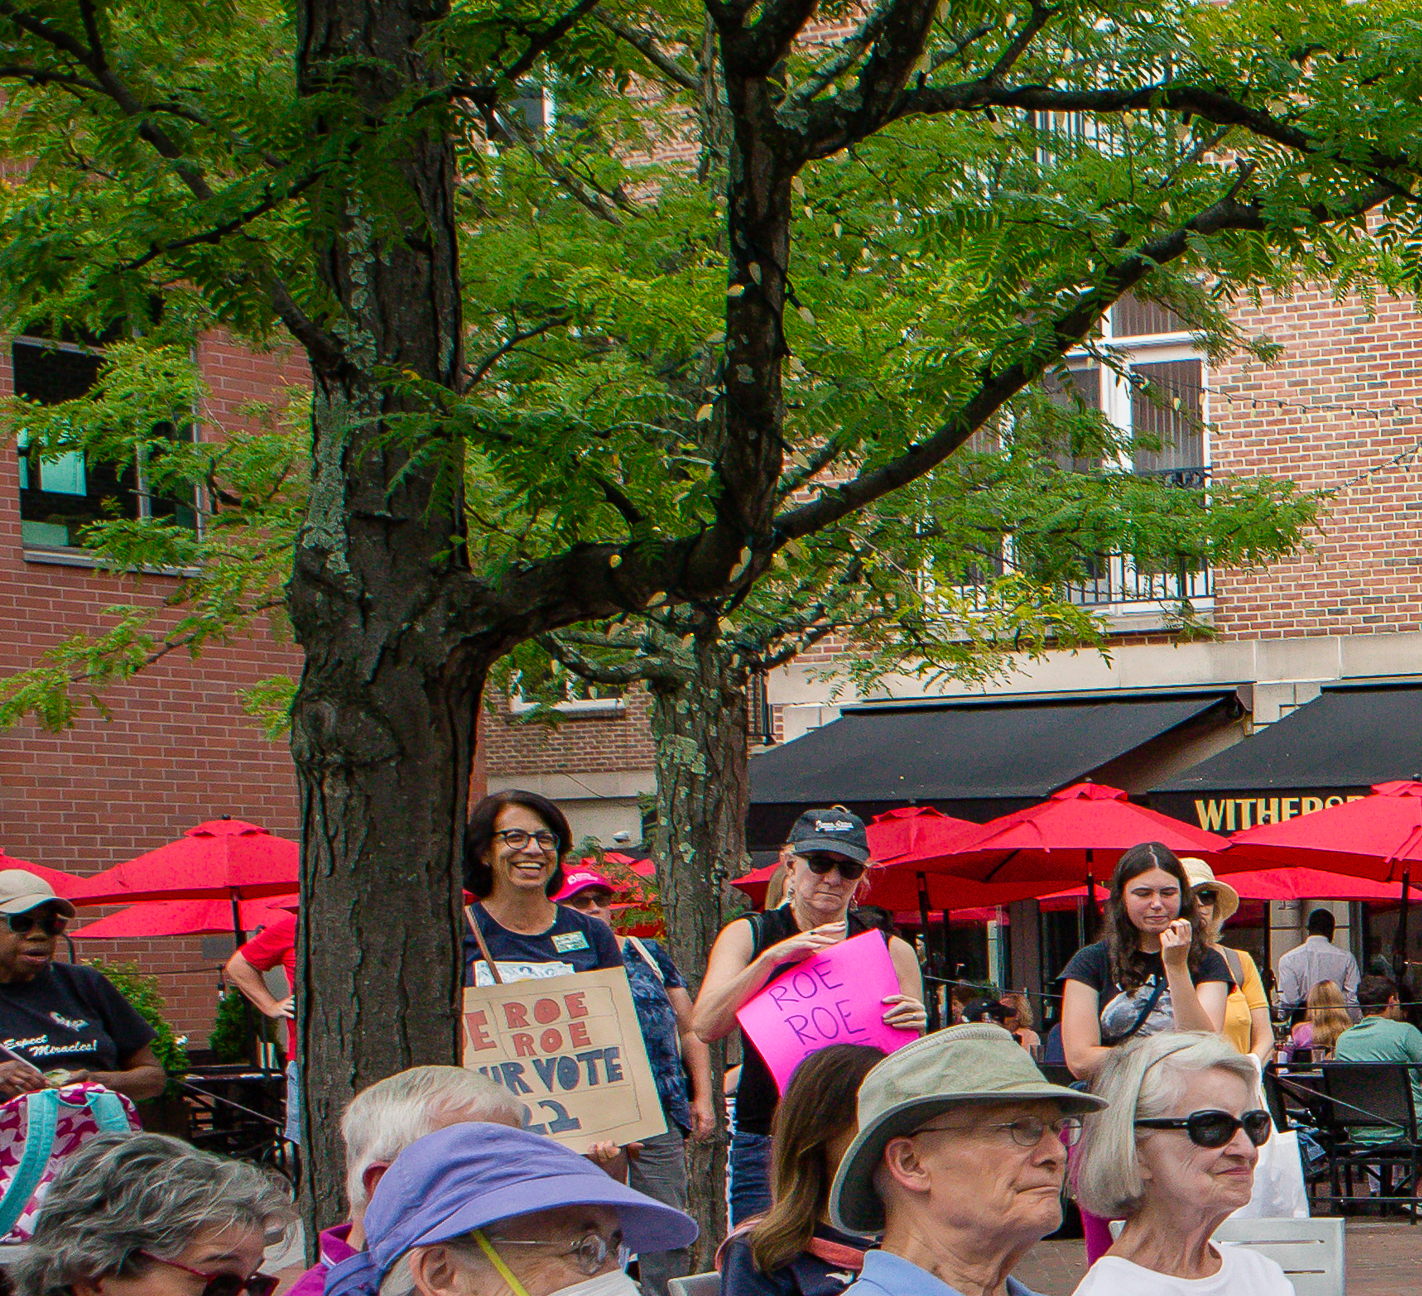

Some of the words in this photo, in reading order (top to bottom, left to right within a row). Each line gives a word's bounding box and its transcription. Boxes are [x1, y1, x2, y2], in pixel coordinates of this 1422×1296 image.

[769, 960, 843, 1011] ROE
[502, 991, 589, 1029] ROE
[784, 999, 866, 1045] ROE
[2, 1034, 48, 1050] Expect
[29, 1039, 98, 1057] Miracles!
[512, 1021, 592, 1057] ROE
[532, 1046, 624, 1092] VOTE
